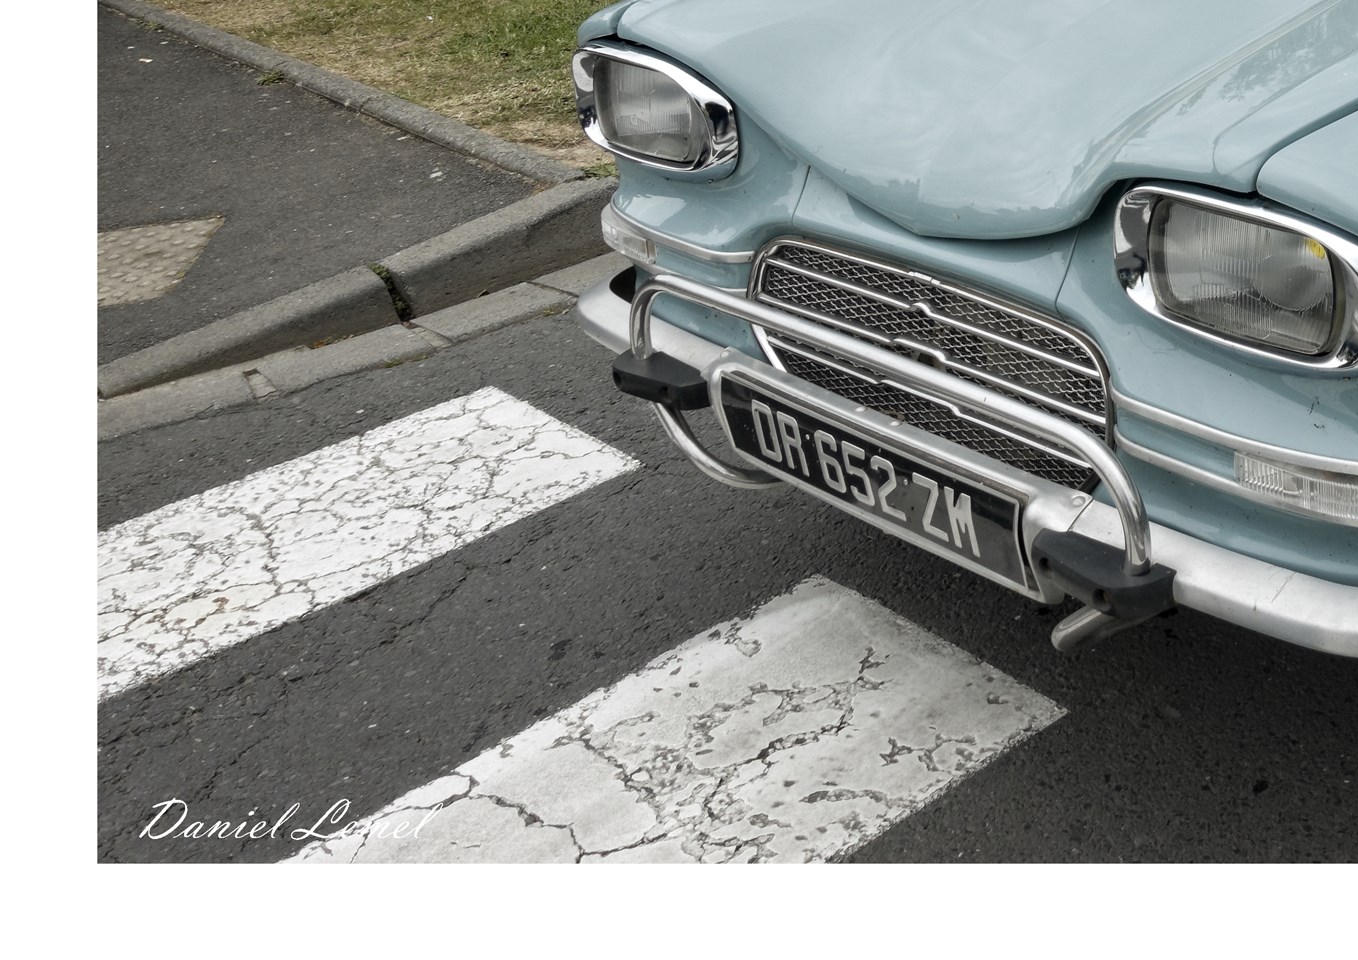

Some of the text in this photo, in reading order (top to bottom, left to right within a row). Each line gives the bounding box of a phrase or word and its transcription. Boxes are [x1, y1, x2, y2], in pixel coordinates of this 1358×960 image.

[751, 398, 981, 558] DR 652 ZM
